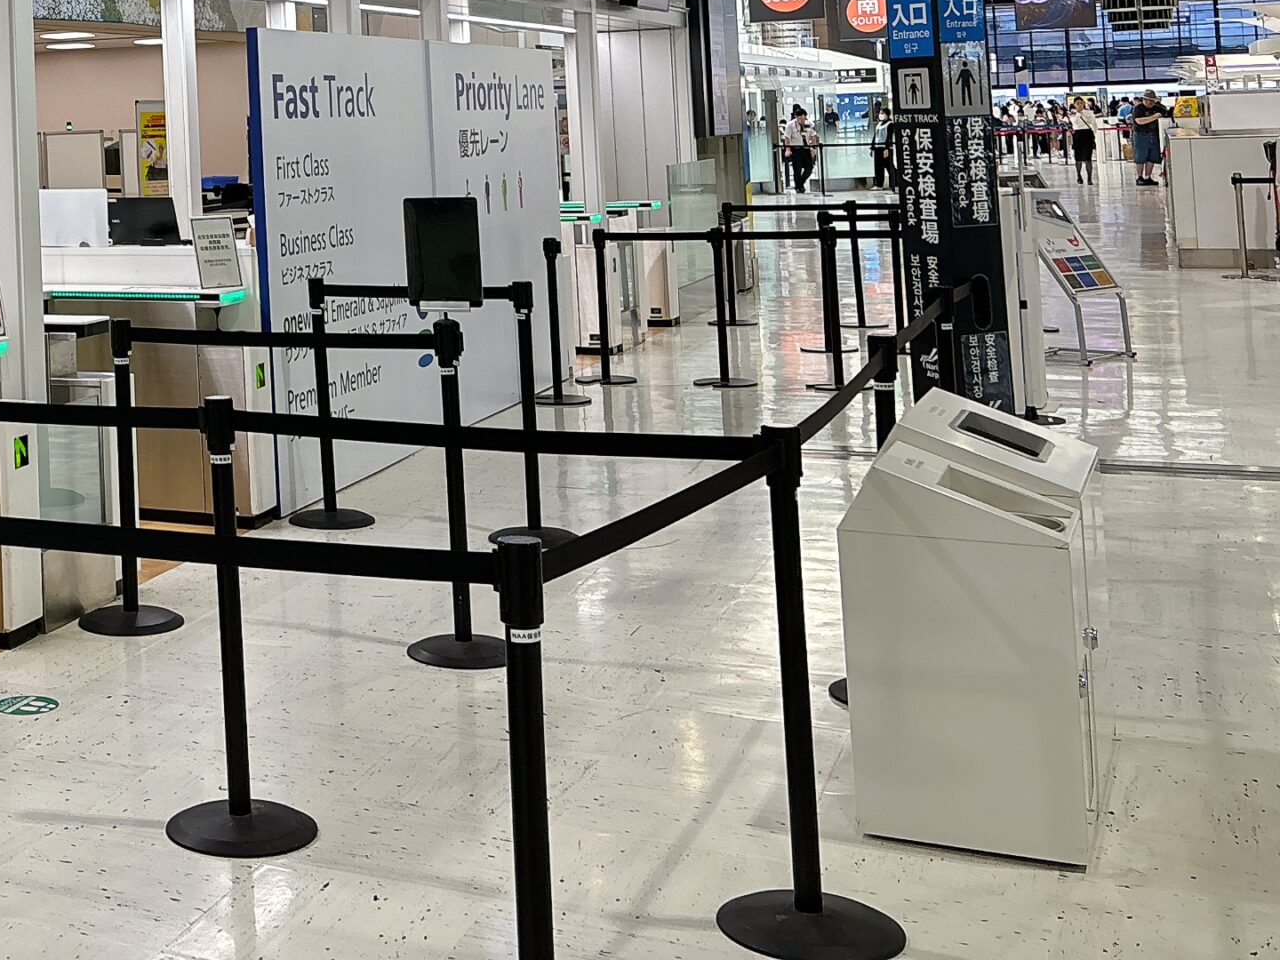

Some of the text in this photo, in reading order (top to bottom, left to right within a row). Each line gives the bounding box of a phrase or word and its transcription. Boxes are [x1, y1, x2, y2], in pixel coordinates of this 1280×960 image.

[851, 16, 888, 26] SOUTH
[891, 3, 927, 27] 入口
[946, 19, 977, 28] Entrance
[892, 30, 930, 40] Entrance
[903, 43, 919, 54] 입구
[272, 72, 376, 119] Fast Track
[455, 71, 545, 121] Priority Lane
[894, 114, 939, 124] FAST TRACK
[458, 128, 508, 158] 優先レーン
[276, 152, 330, 180] First Class
[901, 128, 918, 226] Security Check
[953, 118, 970, 208] Security Check
[966, 116, 990, 222] 保安検査場
[278, 186, 335, 208] ファーストクラス
[914, 127, 940, 245] 保安検査場
[280, 223, 355, 258] Business Class
[282, 261, 334, 285] ビジネスクラス
[926, 255, 940, 288] 安全
[284, 297, 366, 334] onewd Emerald
[287, 380, 337, 413] Premm
[339, 362, 382, 396] Member
